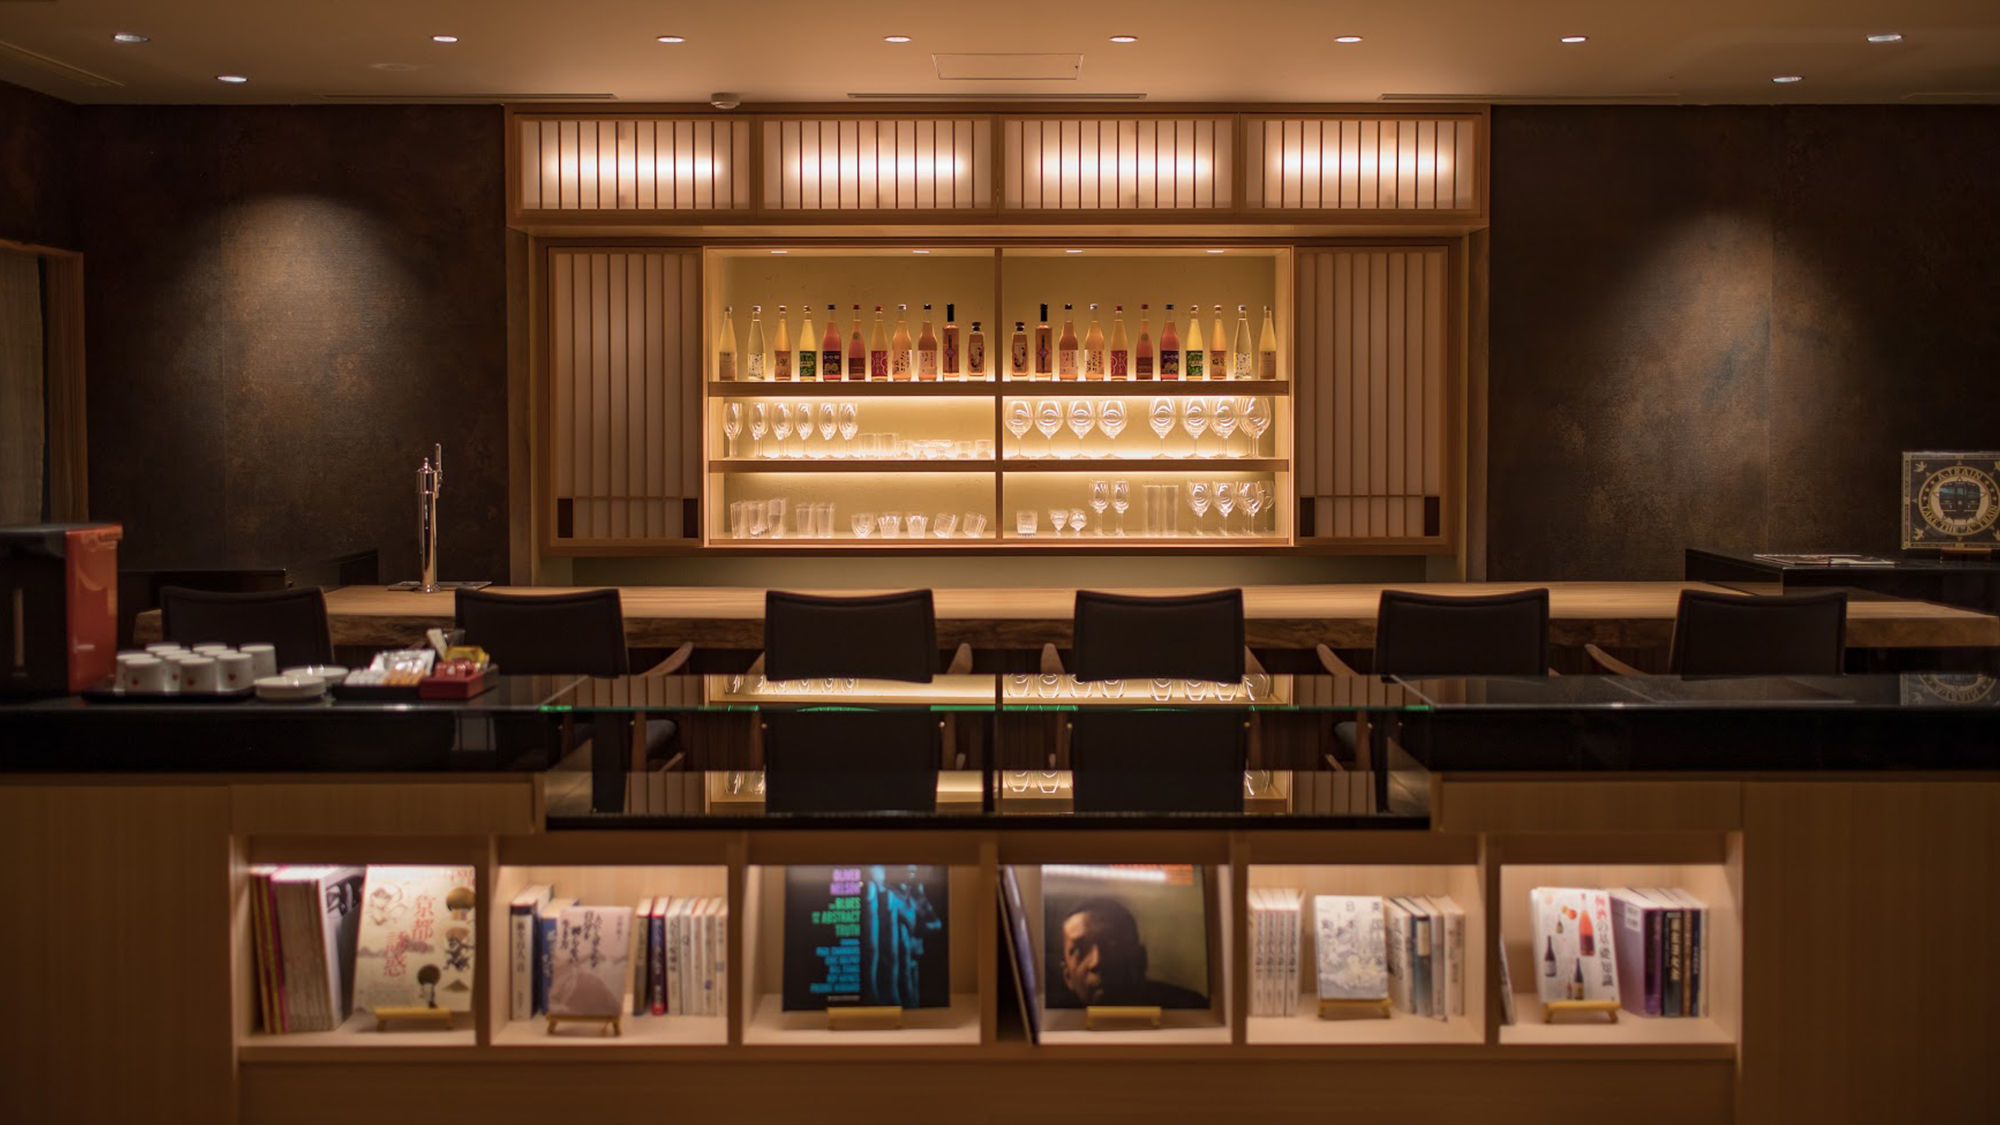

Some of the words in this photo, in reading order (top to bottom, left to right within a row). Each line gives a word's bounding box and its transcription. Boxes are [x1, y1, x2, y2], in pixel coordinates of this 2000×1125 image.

[1922, 504, 1938, 525] TAKE
[1978, 504, 1998, 528] TRAIN
[835, 897, 861, 909] BLUES
[821, 910, 861, 924] ABSTRACT
